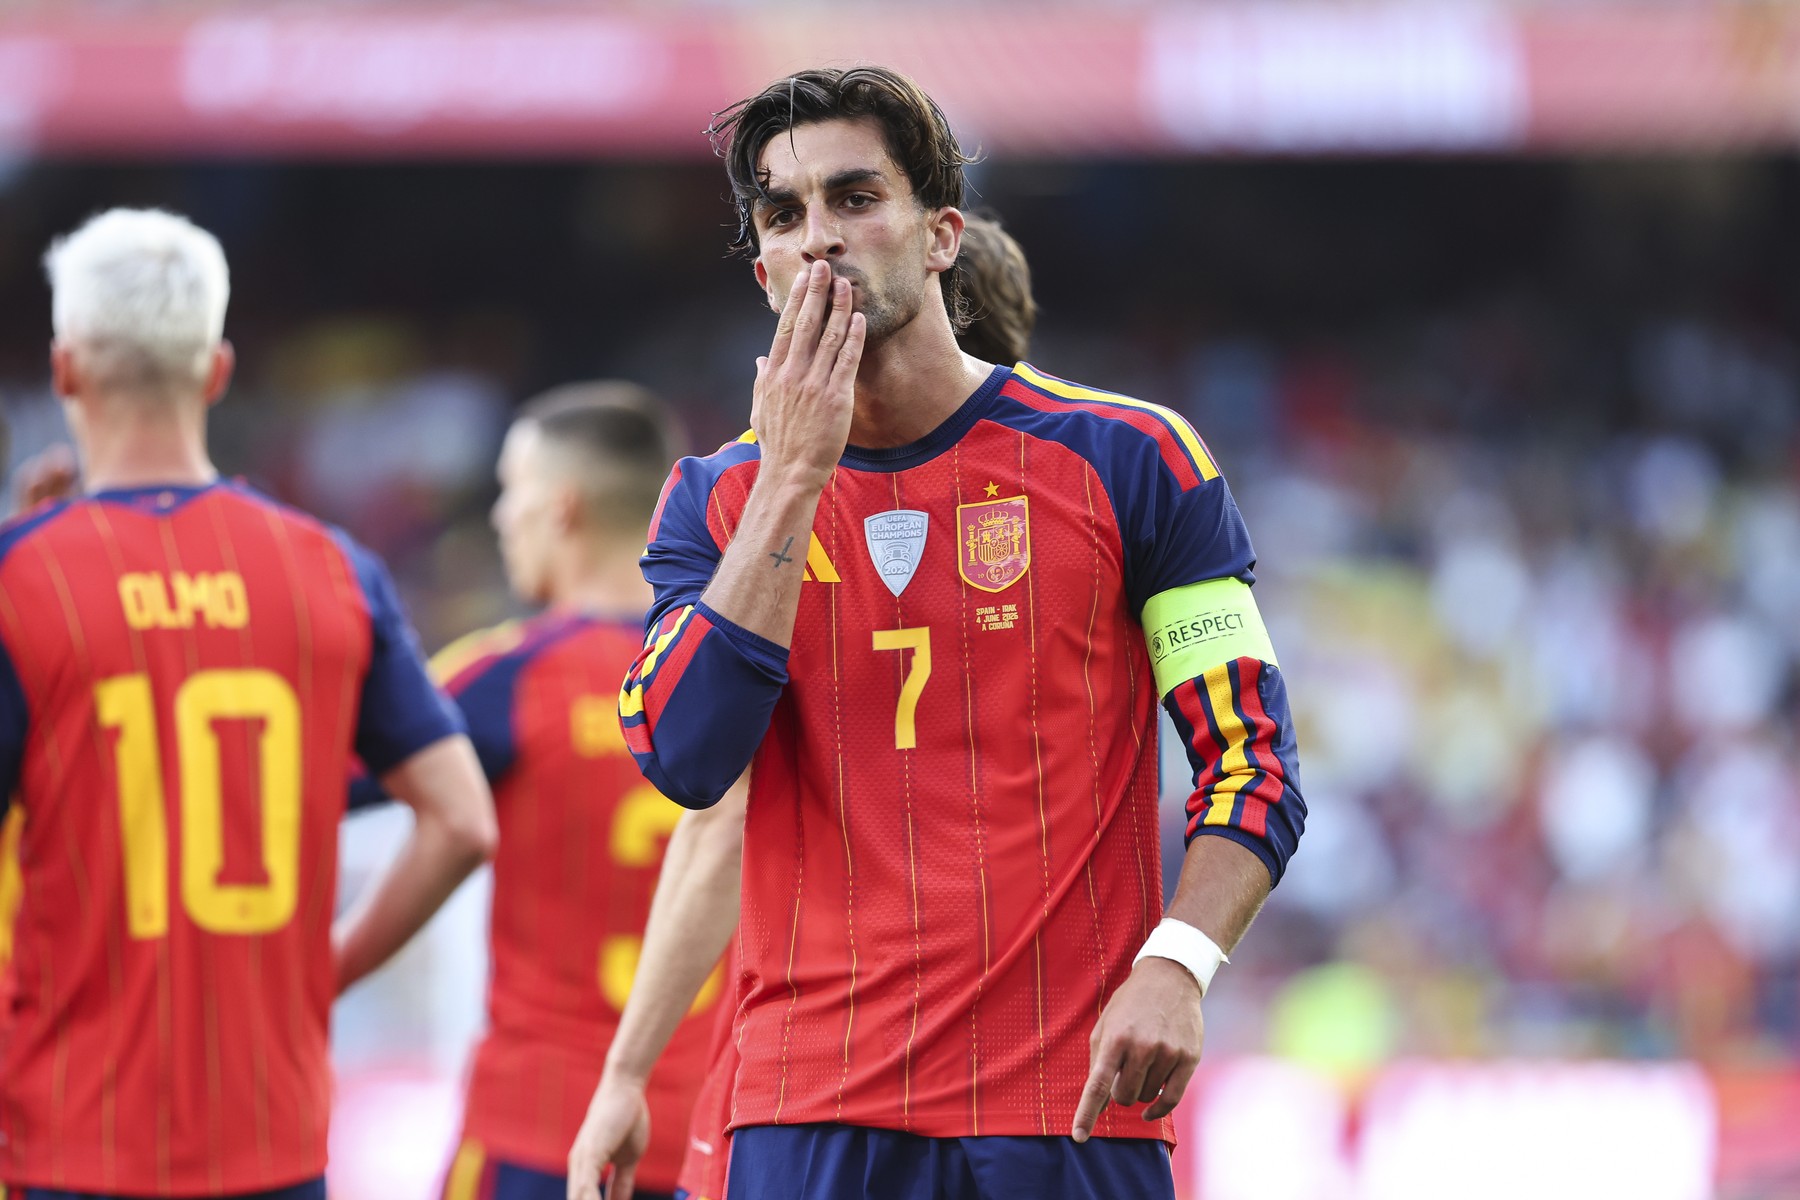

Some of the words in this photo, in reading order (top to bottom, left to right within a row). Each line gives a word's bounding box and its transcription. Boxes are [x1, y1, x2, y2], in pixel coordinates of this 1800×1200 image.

[887, 515, 907, 523] UEFA
[871, 521, 922, 532] EUROPEAN
[871, 530, 923, 540] CHAMPIONS
[885, 566, 910, 575] 2024
[118, 571, 249, 629] OLMO
[976, 606, 996, 616] SPAIN
[976, 616, 981, 624] 4
[983, 614, 1000, 623] JUNE
[981, 623, 987, 631] A
[1167, 613, 1244, 647] RESPECT
[872, 626, 932, 750] 7
[94, 668, 301, 939] 10
